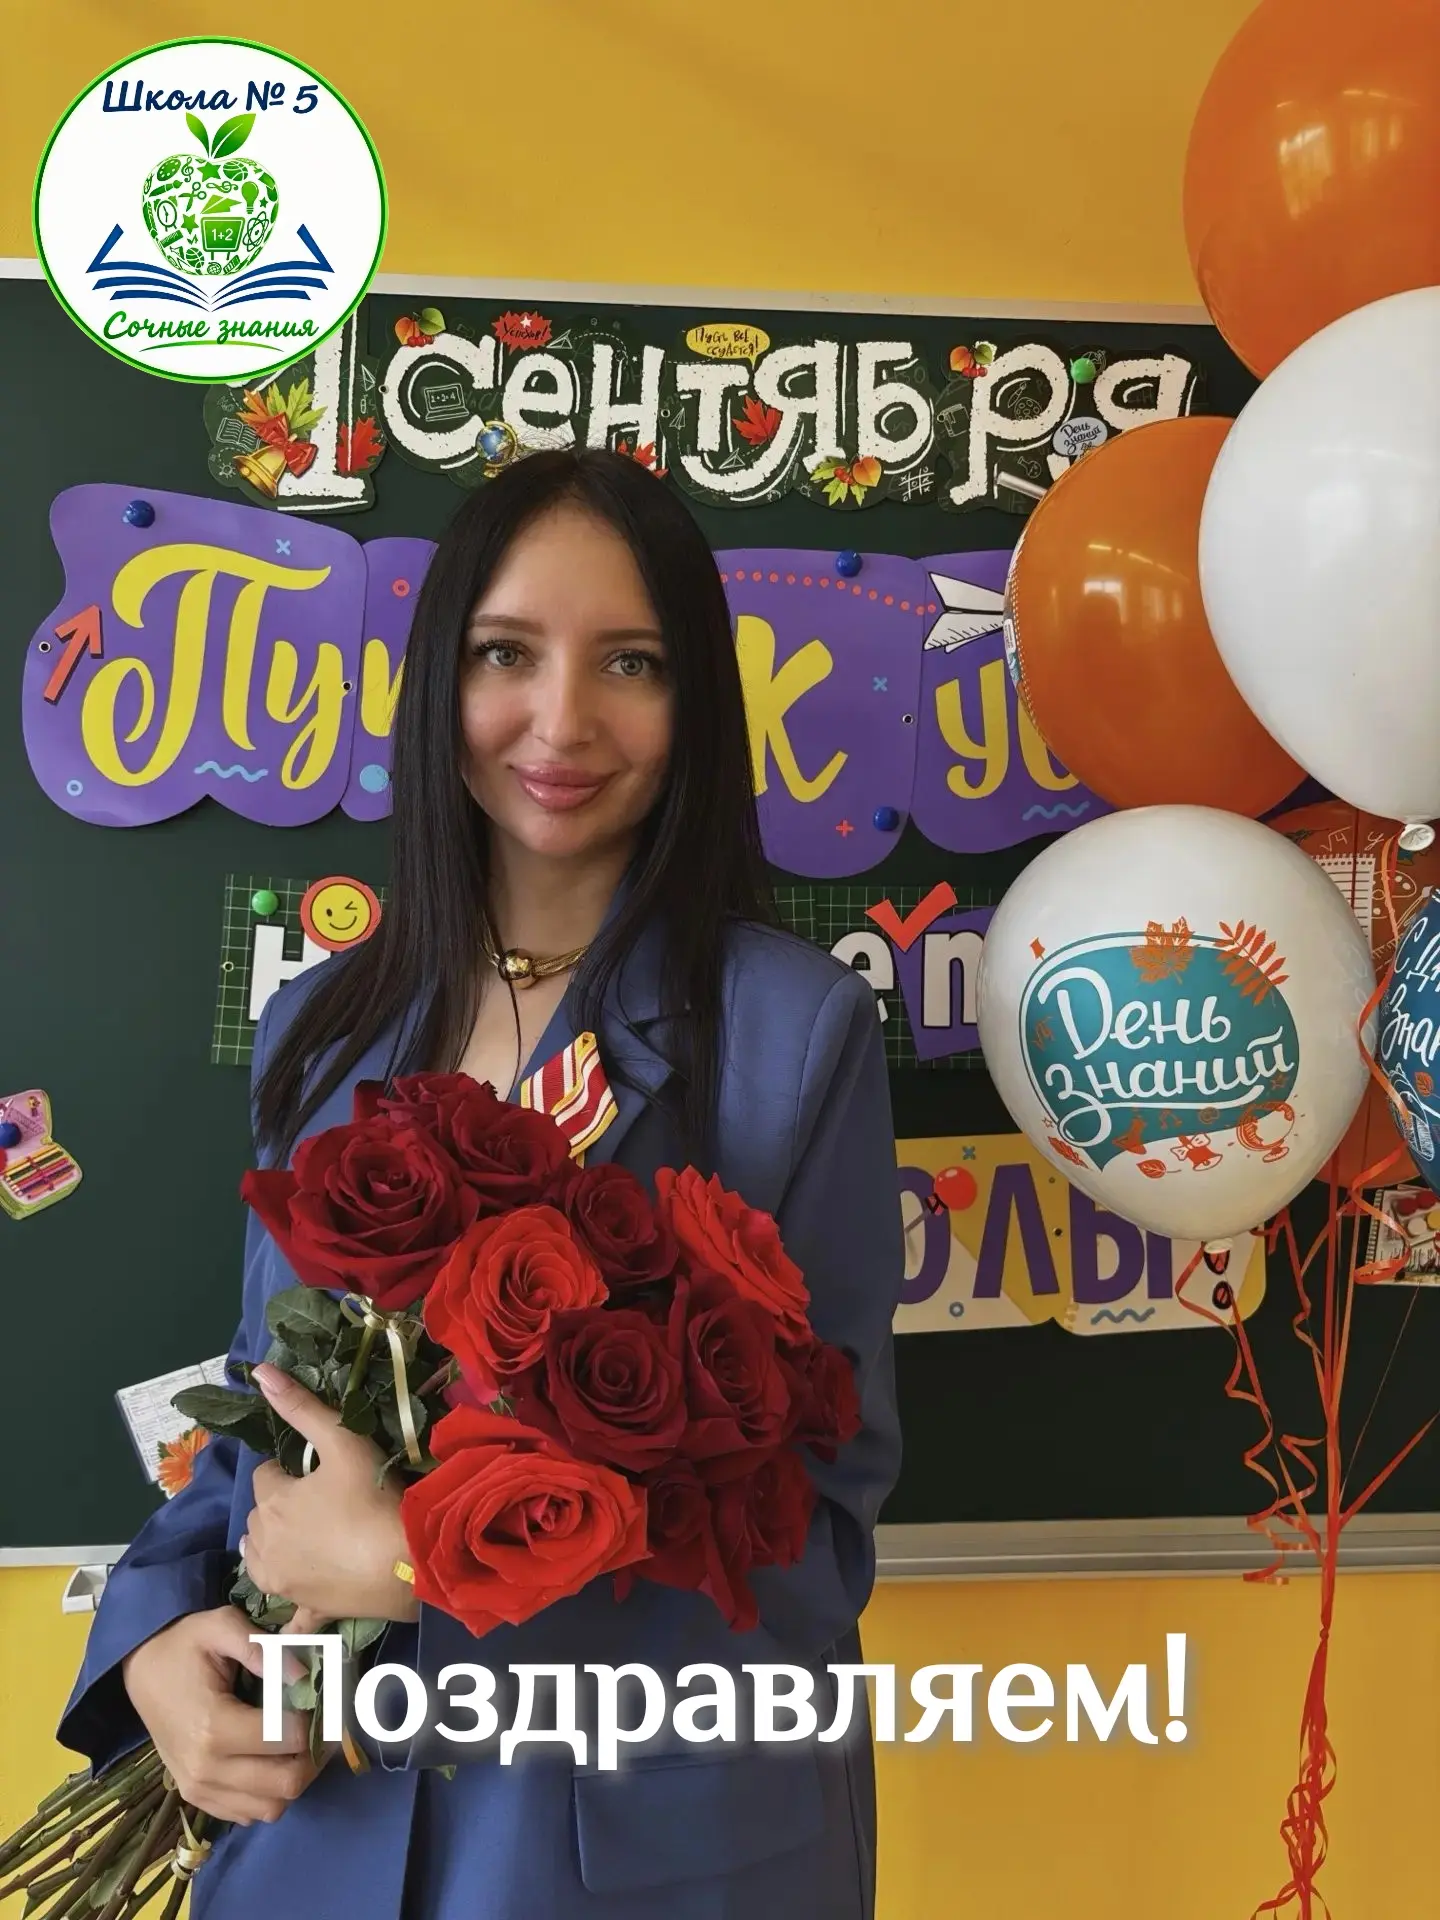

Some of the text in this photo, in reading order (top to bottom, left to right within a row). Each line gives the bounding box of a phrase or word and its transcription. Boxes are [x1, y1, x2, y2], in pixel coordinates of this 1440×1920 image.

[1060, 422, 1091, 438] День
[1038, 966, 1231, 1060] День
[1045, 1025, 1294, 1146] знаний
